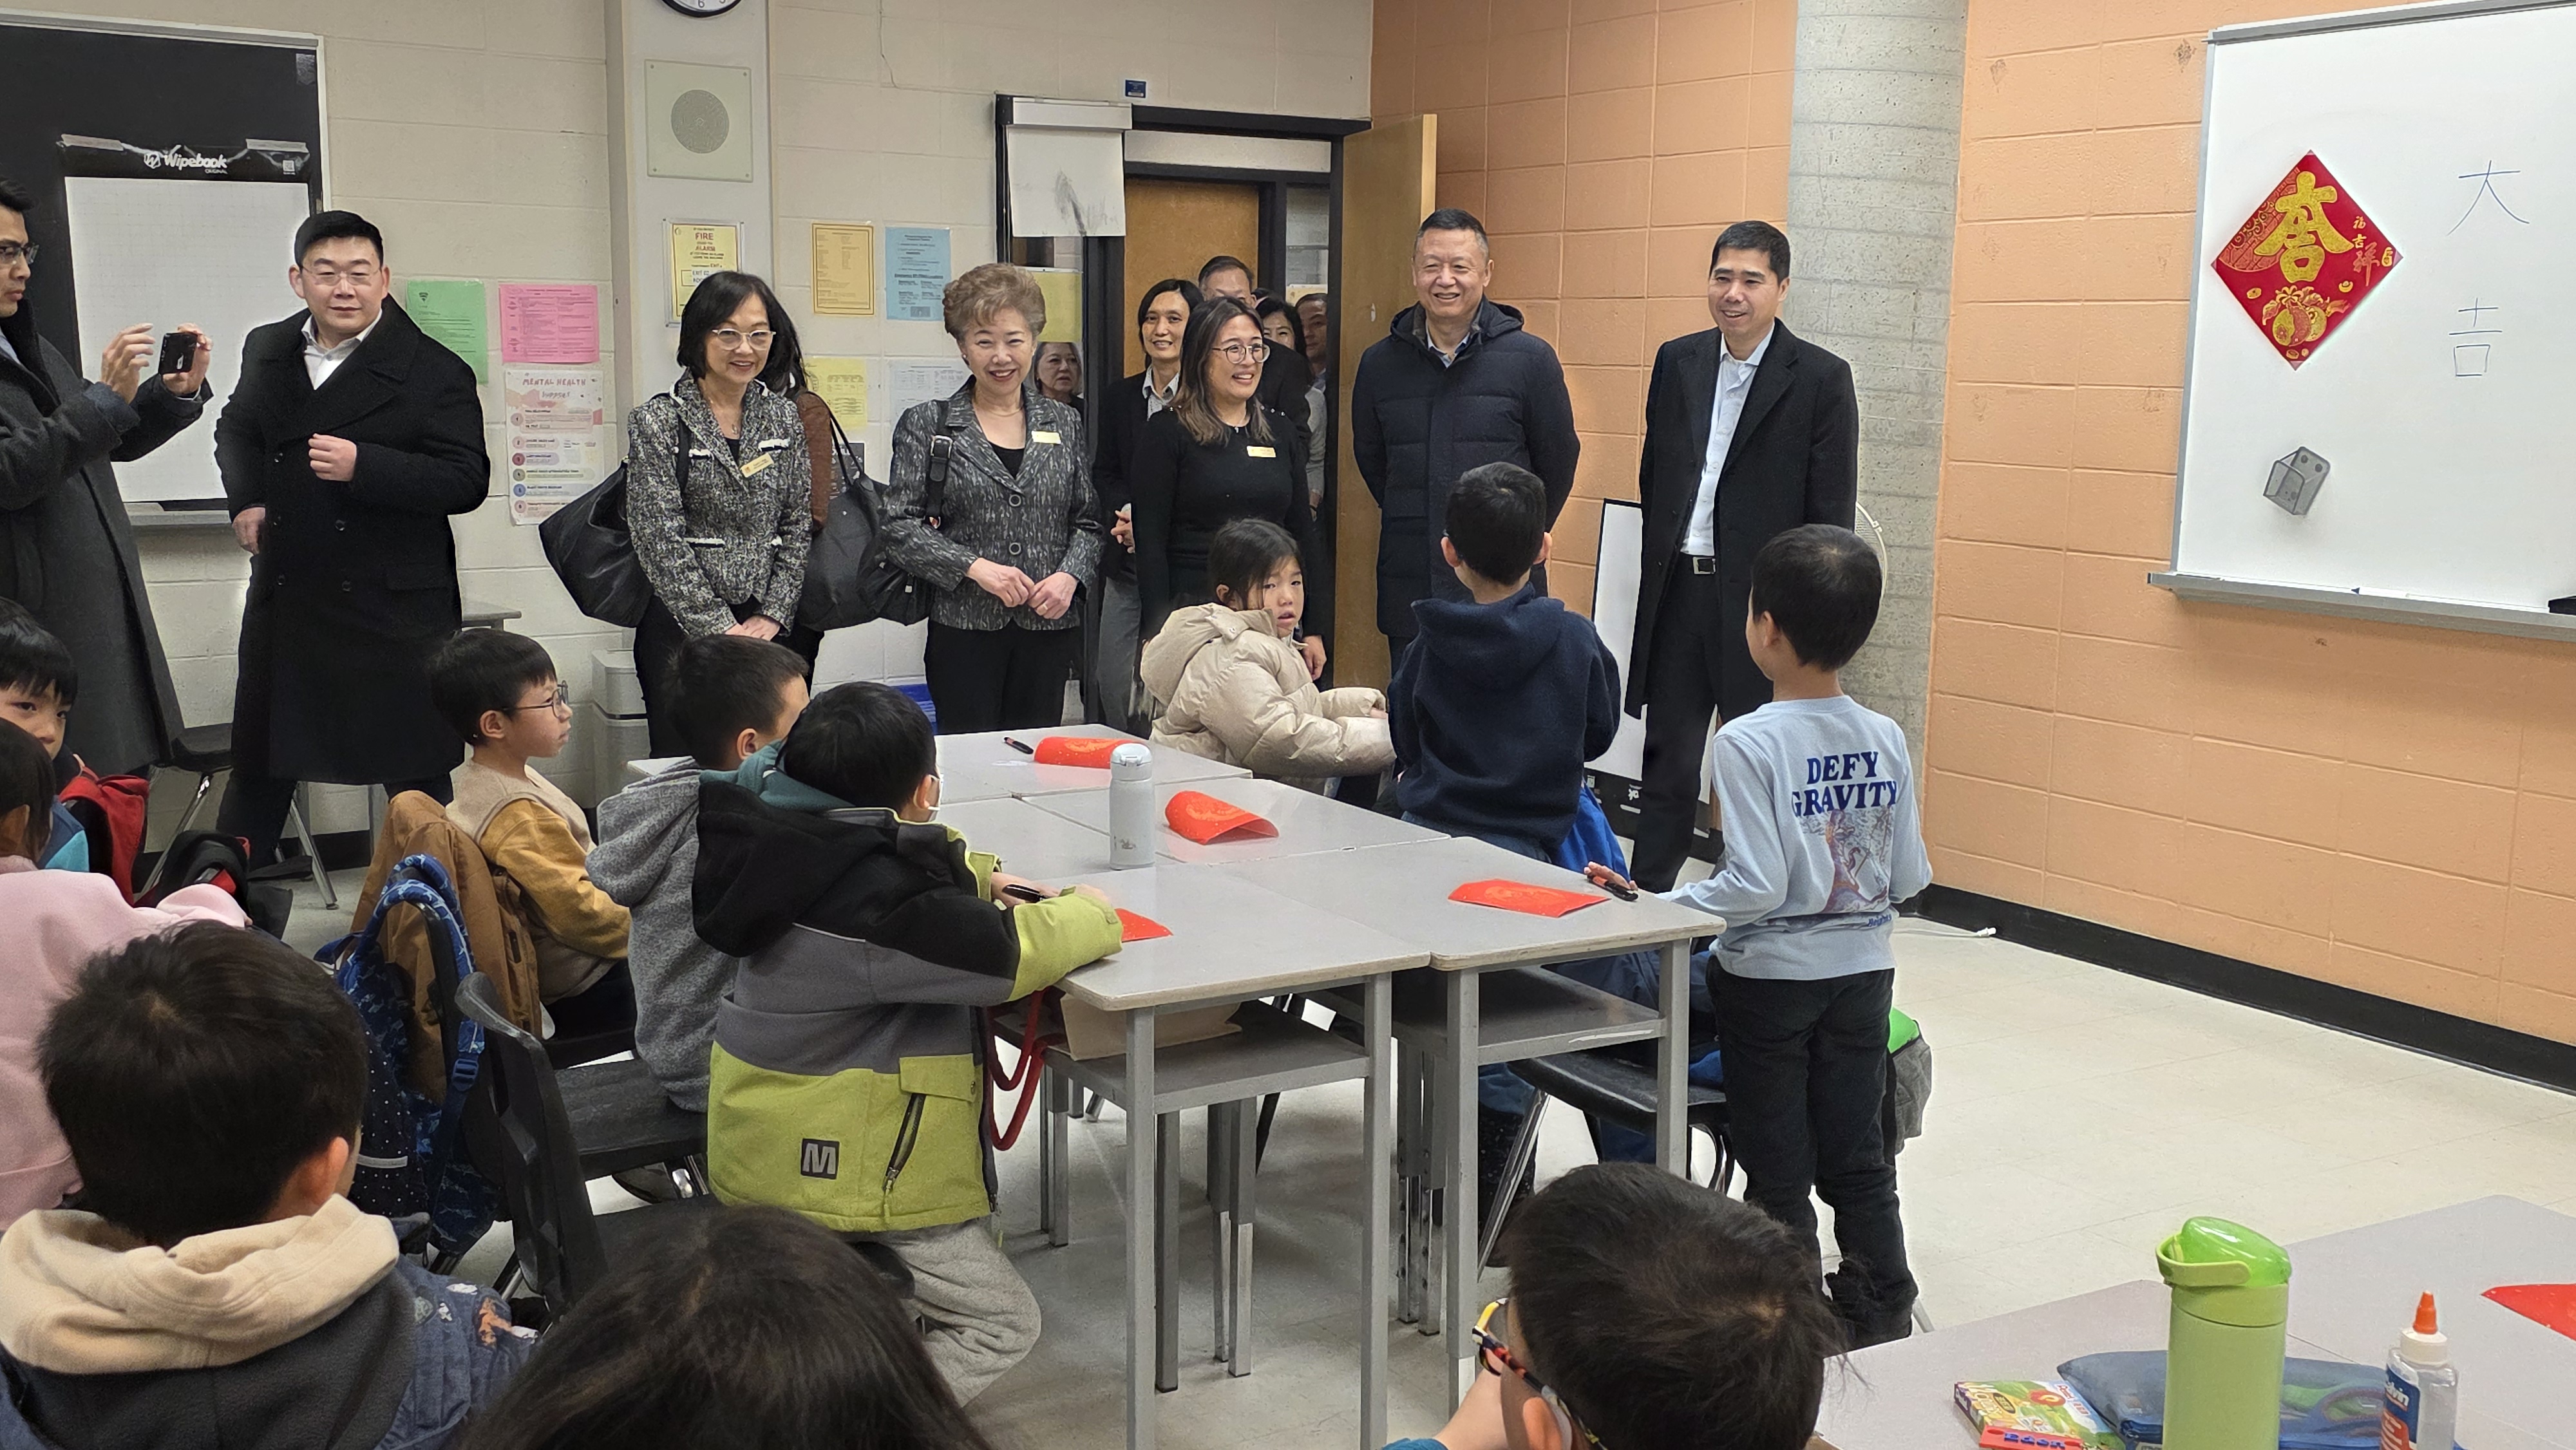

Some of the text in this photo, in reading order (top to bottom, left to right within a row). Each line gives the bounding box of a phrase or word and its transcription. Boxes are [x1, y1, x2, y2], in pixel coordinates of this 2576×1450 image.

[164, 153, 228, 171] Wipebook
[1806, 751, 1879, 785] DEFY
[1791, 780, 1897, 817] GRAVITY
[802, 1143, 836, 1174] M
